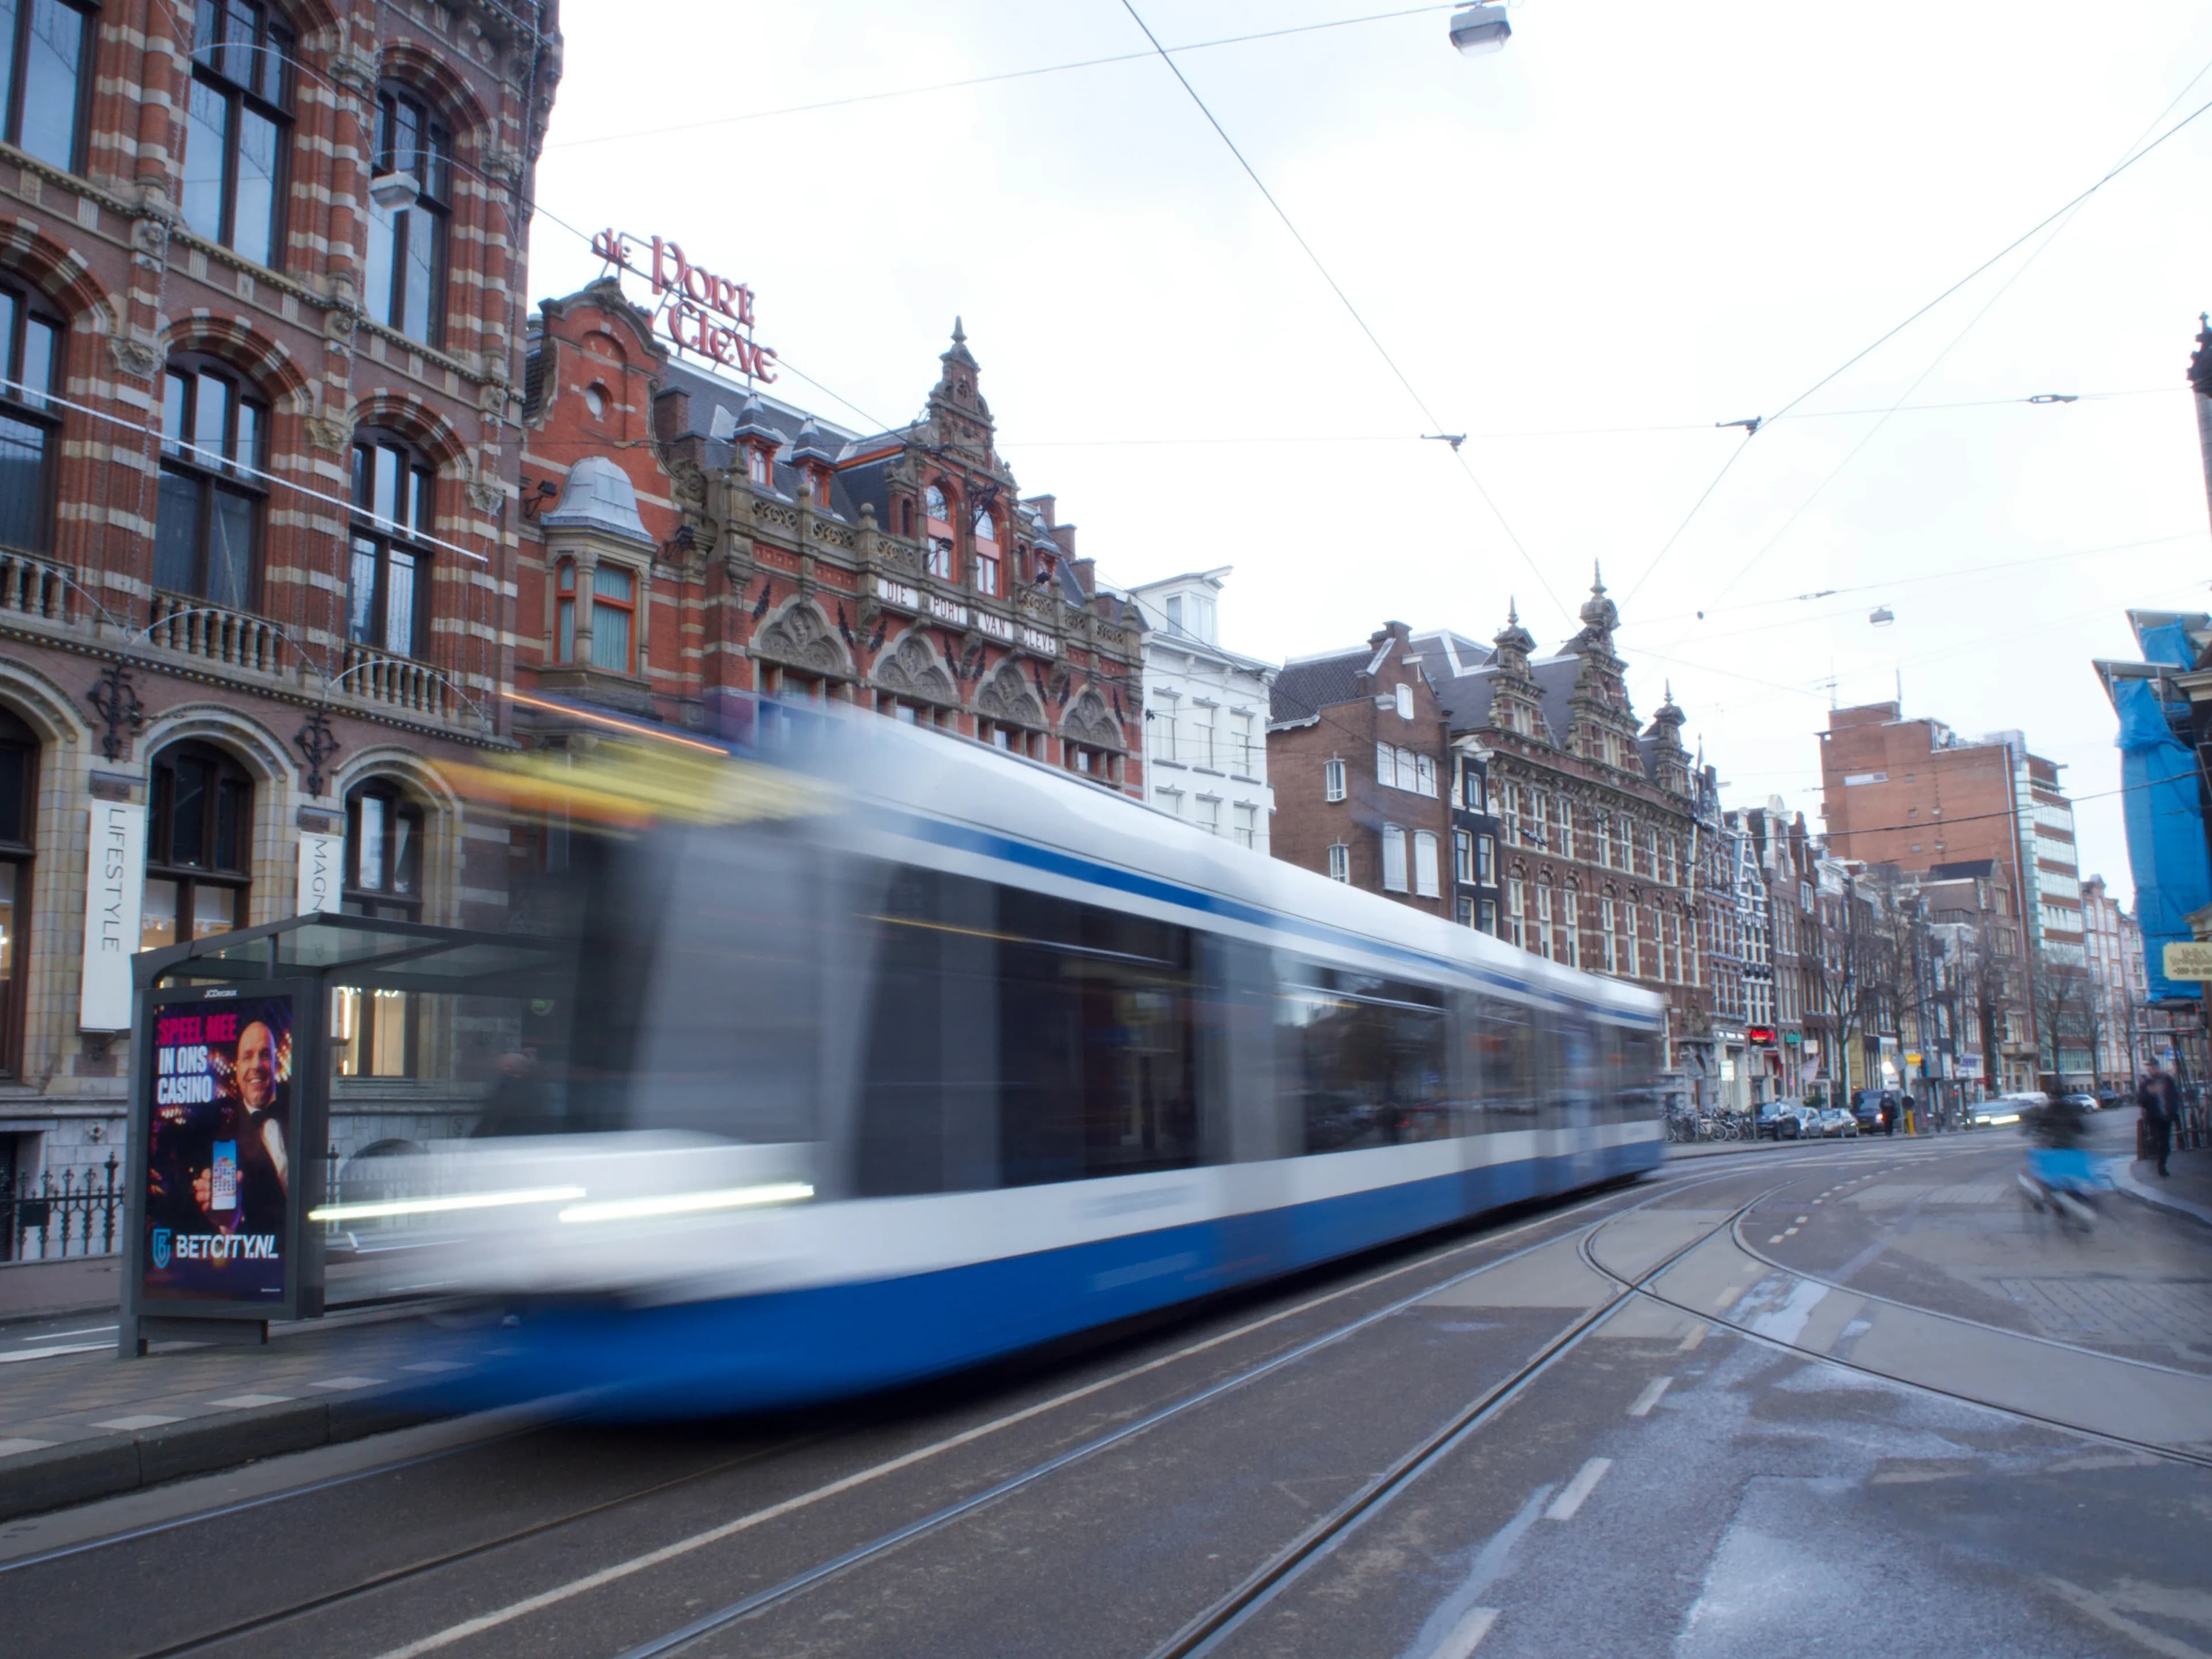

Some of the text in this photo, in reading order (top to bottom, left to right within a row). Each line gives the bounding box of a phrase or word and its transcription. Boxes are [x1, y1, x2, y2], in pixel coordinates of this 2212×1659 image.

[887, 582, 1055, 653] DIE PORT VAN CLEVE
[102, 808, 126, 952] LIFESTYLE
[204, 990, 237, 998] JCDecaux
[158, 1014, 237, 1044] SPEEL MEE
[158, 1046, 208, 1074] IN ONS
[158, 1075, 213, 1104] CASINO
[176, 1234, 279, 1258] BETCITY.NL
